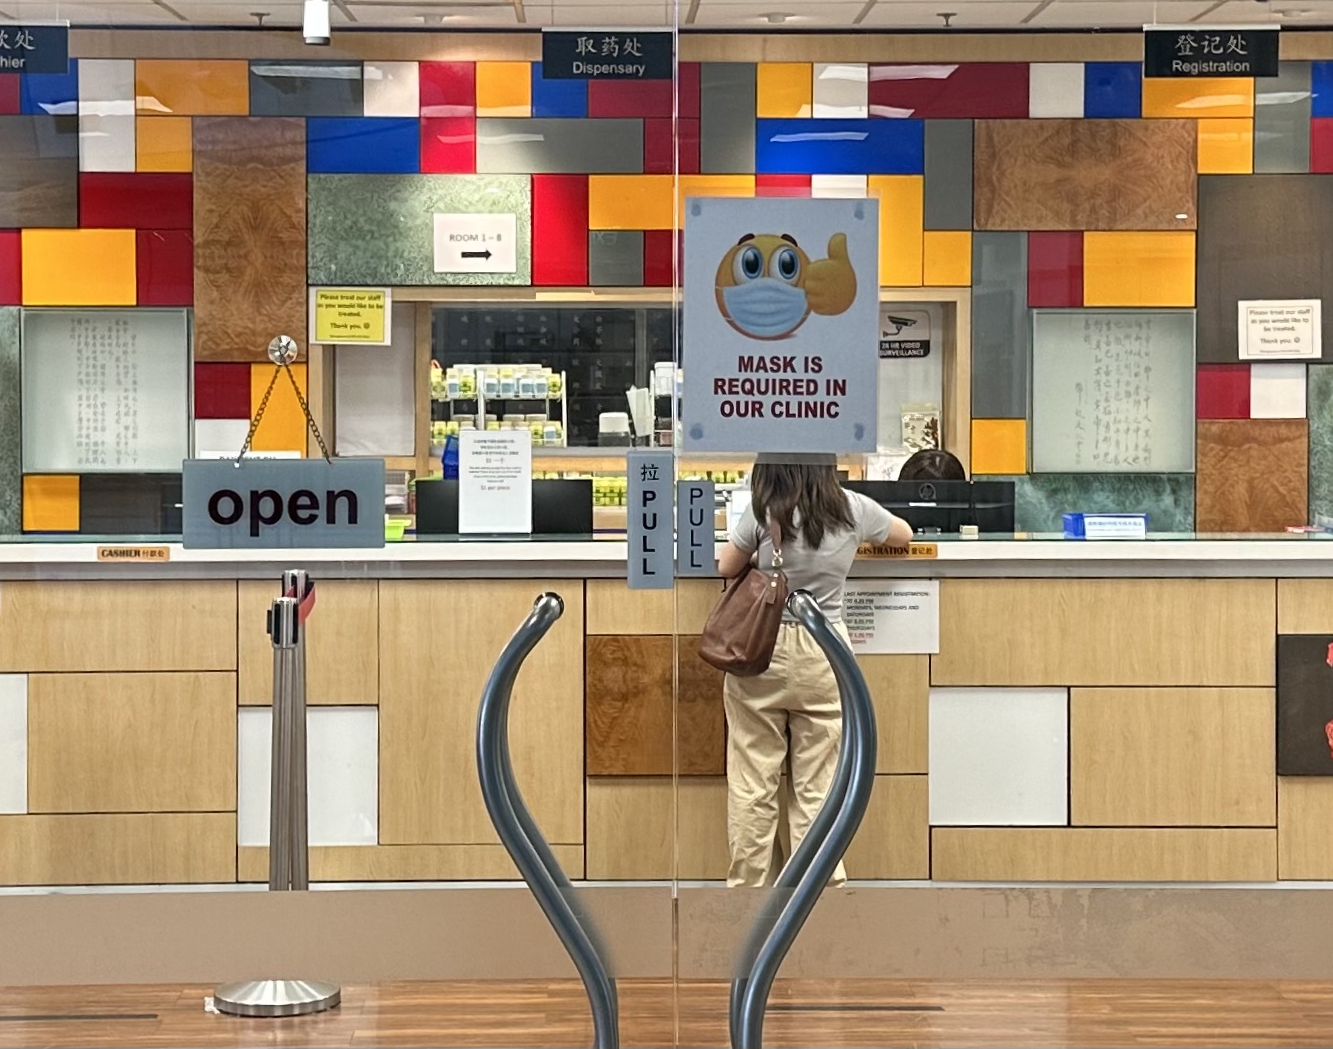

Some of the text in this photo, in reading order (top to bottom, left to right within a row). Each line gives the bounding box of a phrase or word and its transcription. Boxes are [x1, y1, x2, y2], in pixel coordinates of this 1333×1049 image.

[576, 36, 643, 57] 取药处
[1175, 34, 1248, 56] 登记处
[573, 62, 645, 76] Dispensary
[1172, 60, 1250, 75] Registration
[738, 356, 823, 374] MASK IS
[714, 378, 846, 396] REQUIRED IN
[720, 400, 839, 418] OUR CLINIC
[641, 464, 659, 481] 拉
[208, 489, 358, 537] open
[643, 491, 657, 575] PULL
[690, 488, 703, 567] PULL
[101, 549, 140, 558] CASHIER
